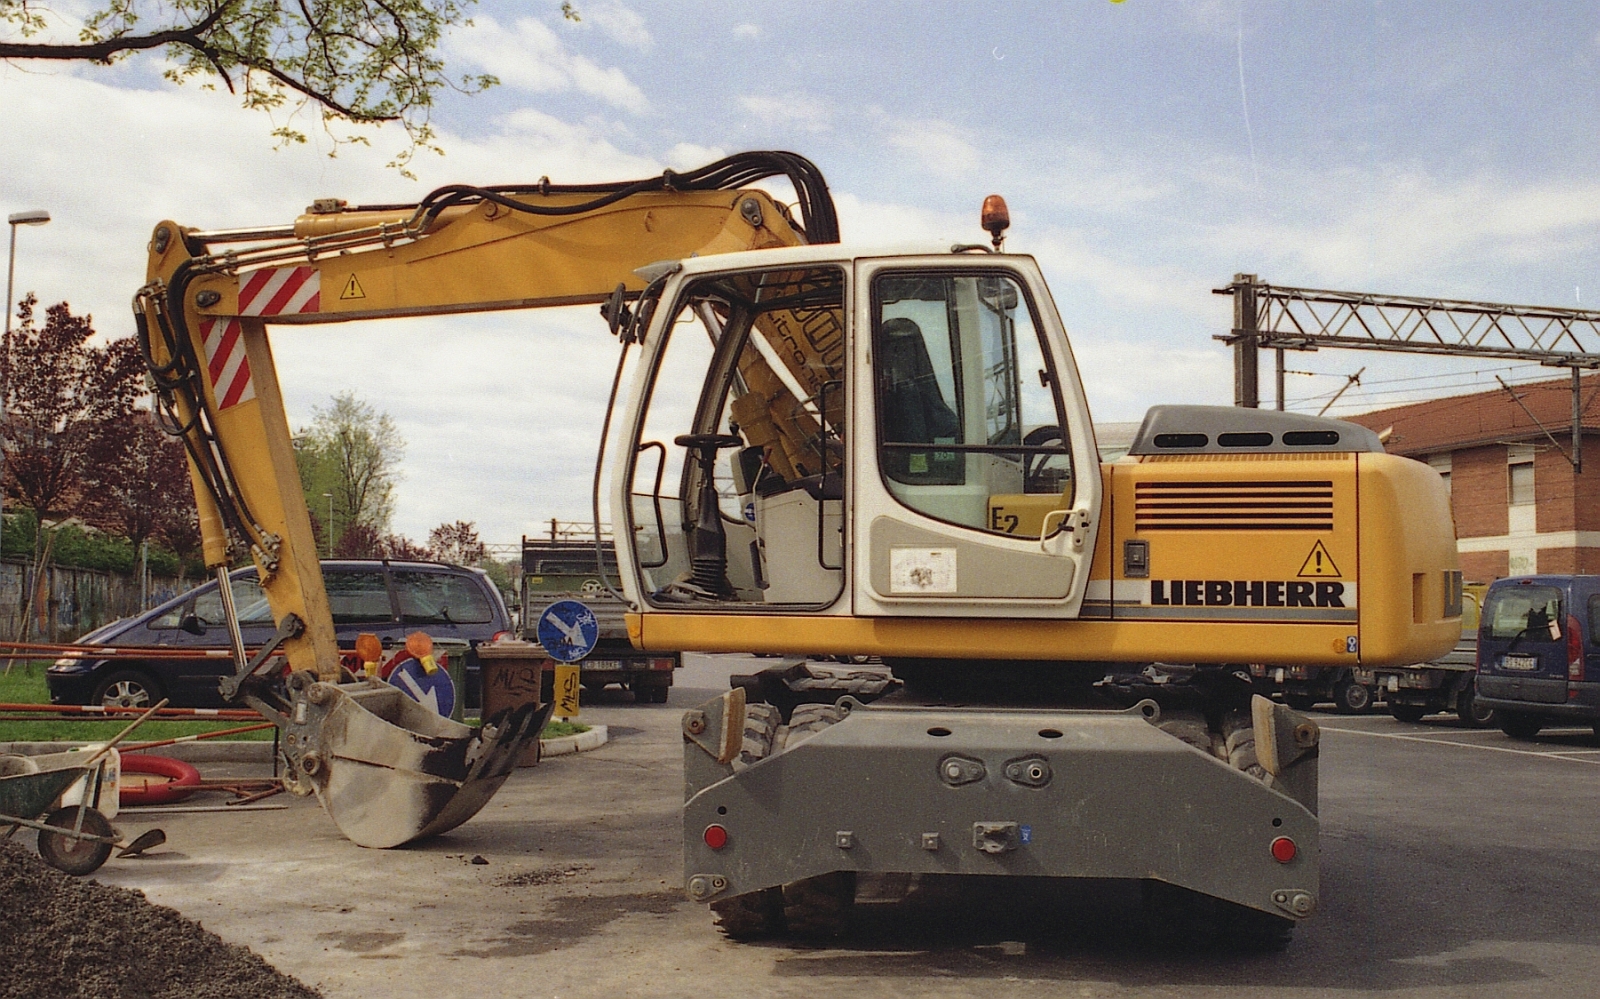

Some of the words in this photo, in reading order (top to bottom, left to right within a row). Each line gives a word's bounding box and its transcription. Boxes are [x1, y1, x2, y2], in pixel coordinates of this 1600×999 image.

[992, 507, 1019, 533] E2
[1151, 580, 1345, 607] LIEBHERR
[561, 672, 577, 712] MLS
